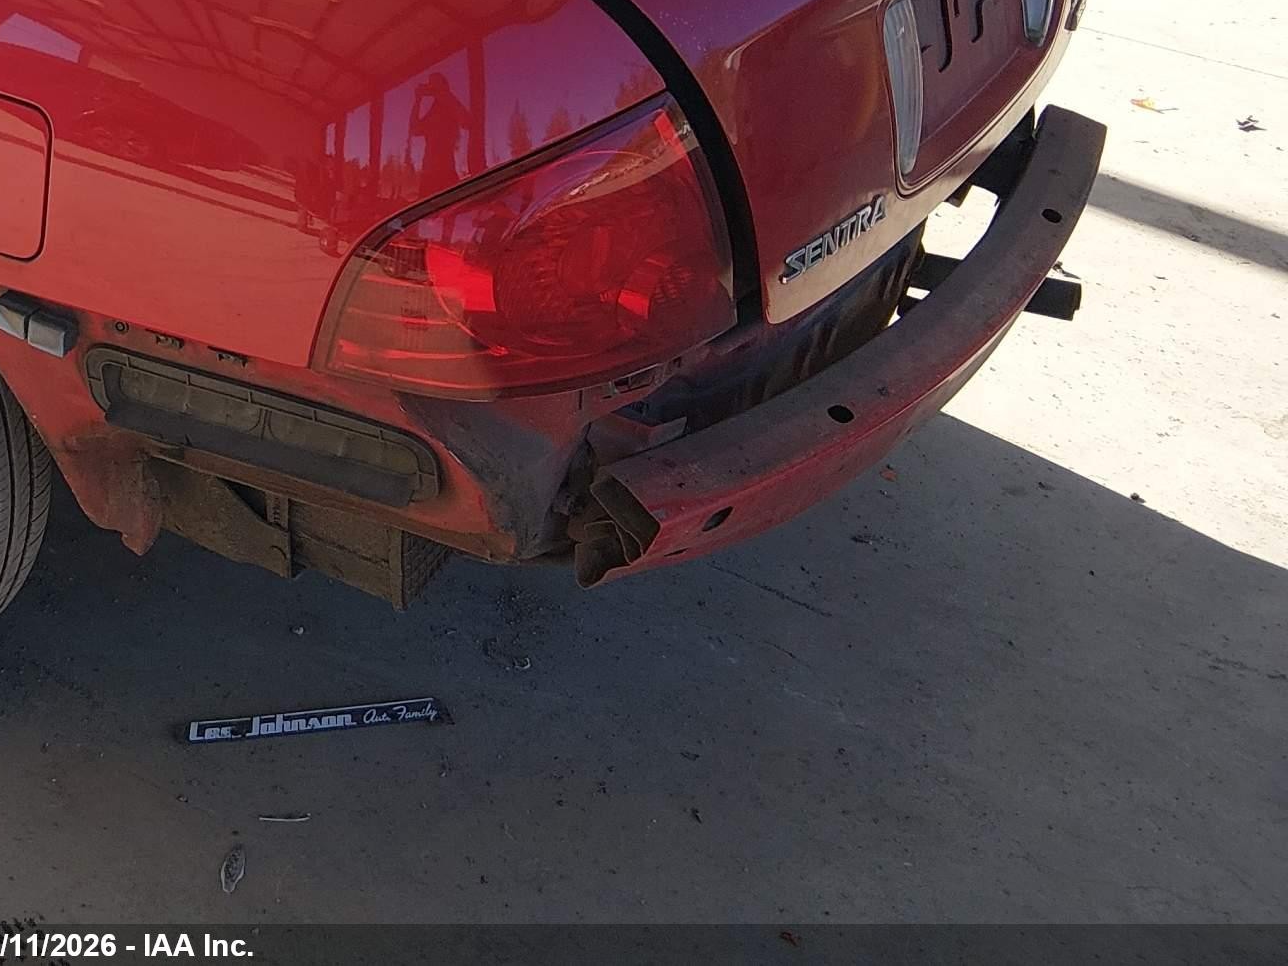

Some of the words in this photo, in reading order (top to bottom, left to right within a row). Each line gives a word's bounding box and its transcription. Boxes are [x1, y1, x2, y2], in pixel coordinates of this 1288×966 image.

[779, 194, 887, 284] SENTRA
[245, 714, 357, 737] Johnson
[392, 702, 439, 722] Family
